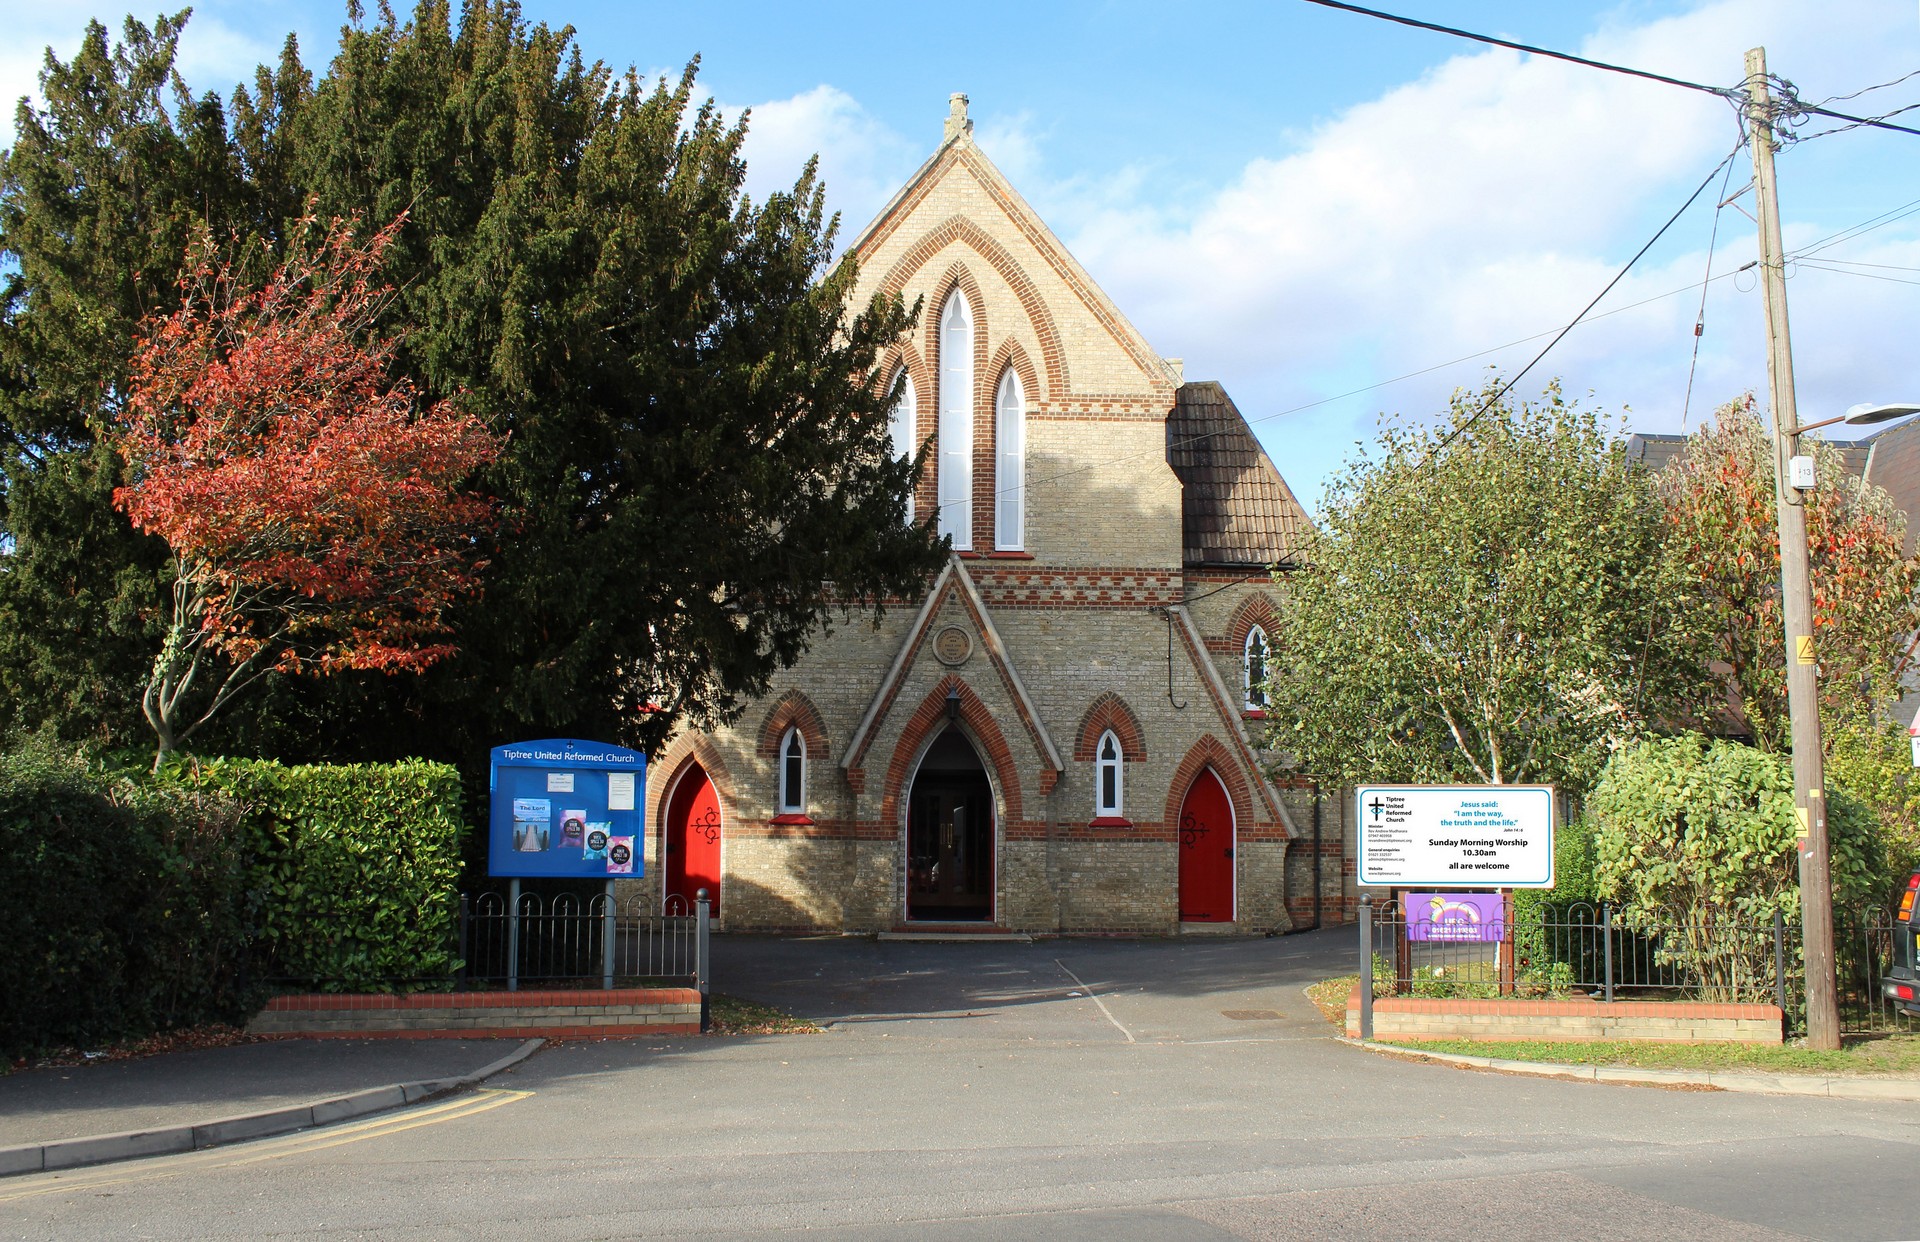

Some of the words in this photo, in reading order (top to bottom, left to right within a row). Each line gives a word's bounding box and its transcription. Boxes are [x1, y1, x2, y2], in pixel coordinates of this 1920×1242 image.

[504, 750, 532, 760] Tiptree
[535, 751, 562, 760] United
[565, 752, 603, 761] Reformed
[606, 754, 634, 762] Church
[1429, 839, 1458, 847] Sunday
[1460, 839, 1494, 847] Morning
[1495, 839, 1528, 847] Worship
